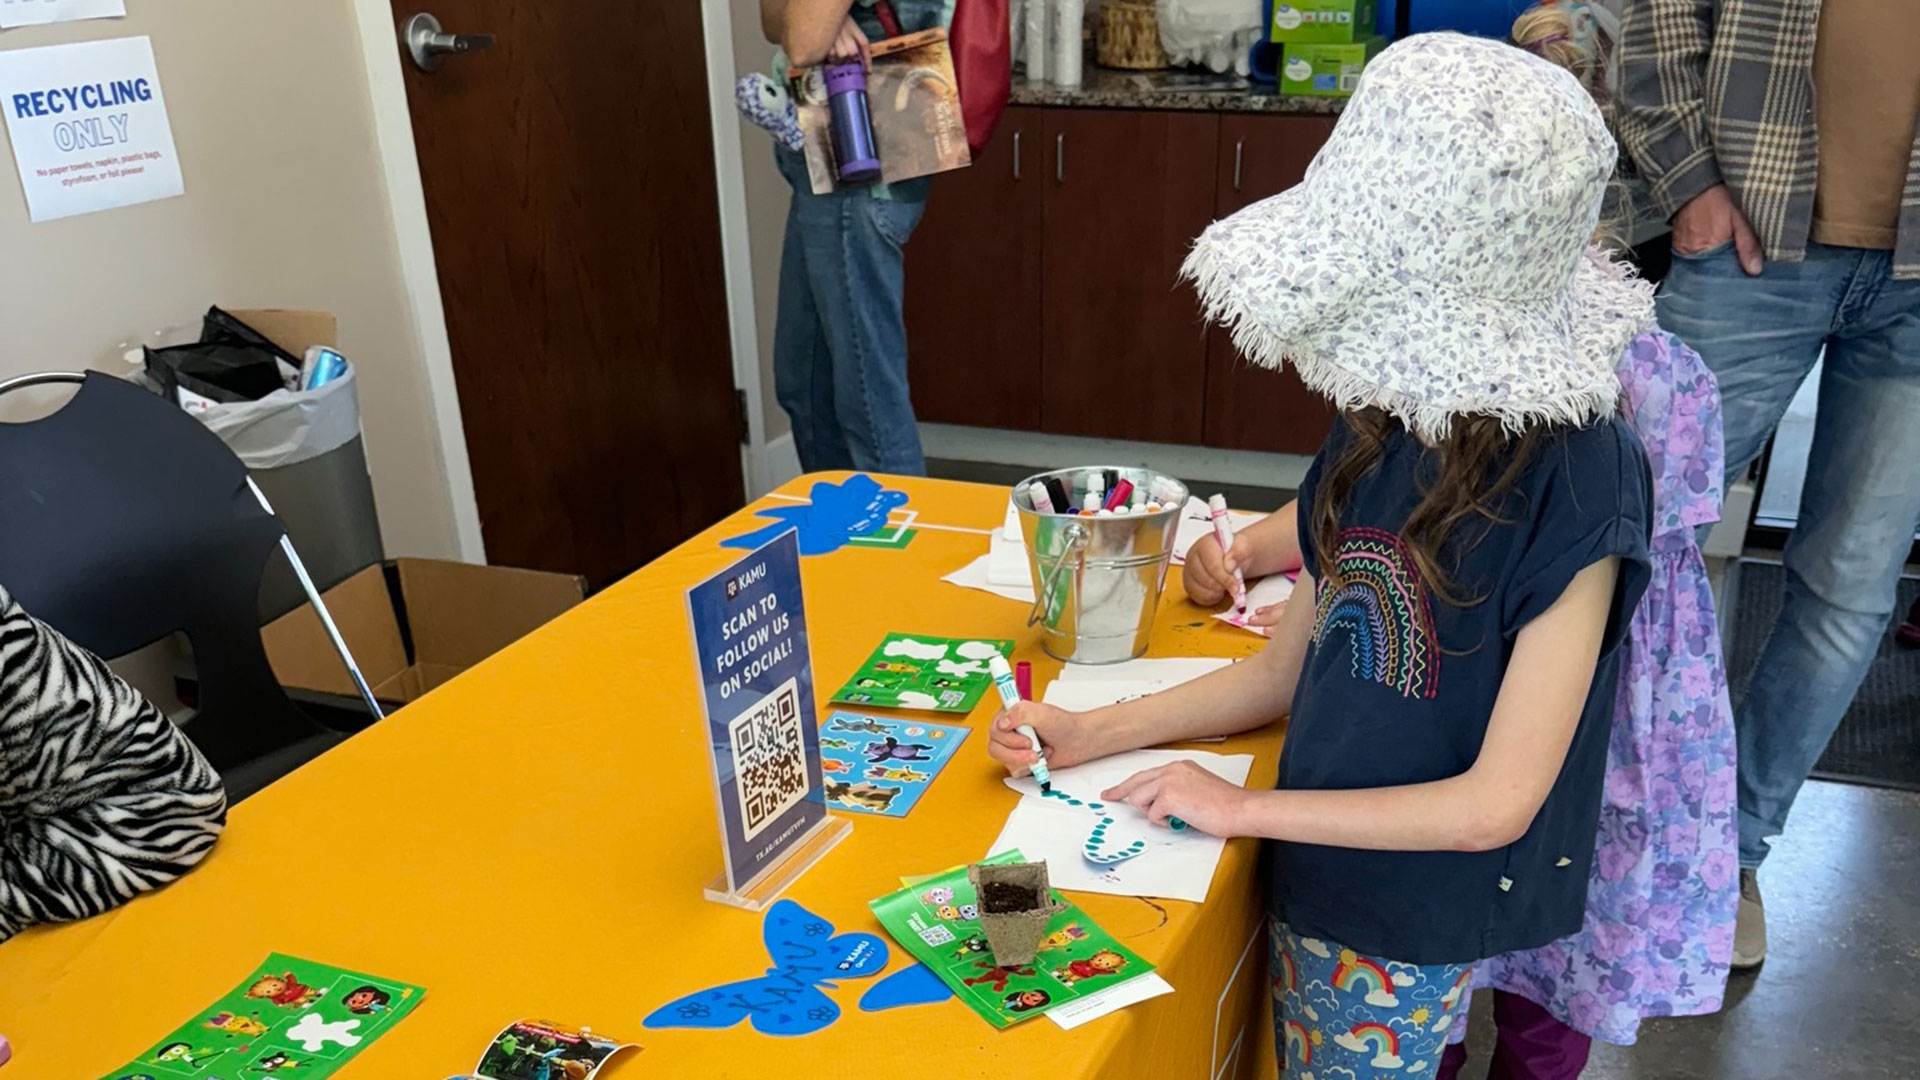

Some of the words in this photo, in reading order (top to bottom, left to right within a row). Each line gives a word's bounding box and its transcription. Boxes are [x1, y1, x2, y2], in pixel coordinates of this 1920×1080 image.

[12, 78, 152, 119] RECYCLING
[54, 113, 129, 152] ONLY
[37, 168, 48, 177] No
[48, 166, 69, 176] paper
[120, 153, 143, 164] plastic
[107, 169, 119, 178] foil
[738, 562, 767, 590] KAMU
[721, 604, 757, 640] SCAN
[759, 592, 777, 615] TO
[716, 624, 769, 674] FOLLOW
[772, 612, 789, 635] US
[720, 673, 741, 699] ON
[743, 637, 793, 684] SOCIAL!
[846, 940, 870, 961] KAMU
[726, 940, 824, 1014] KAMU
